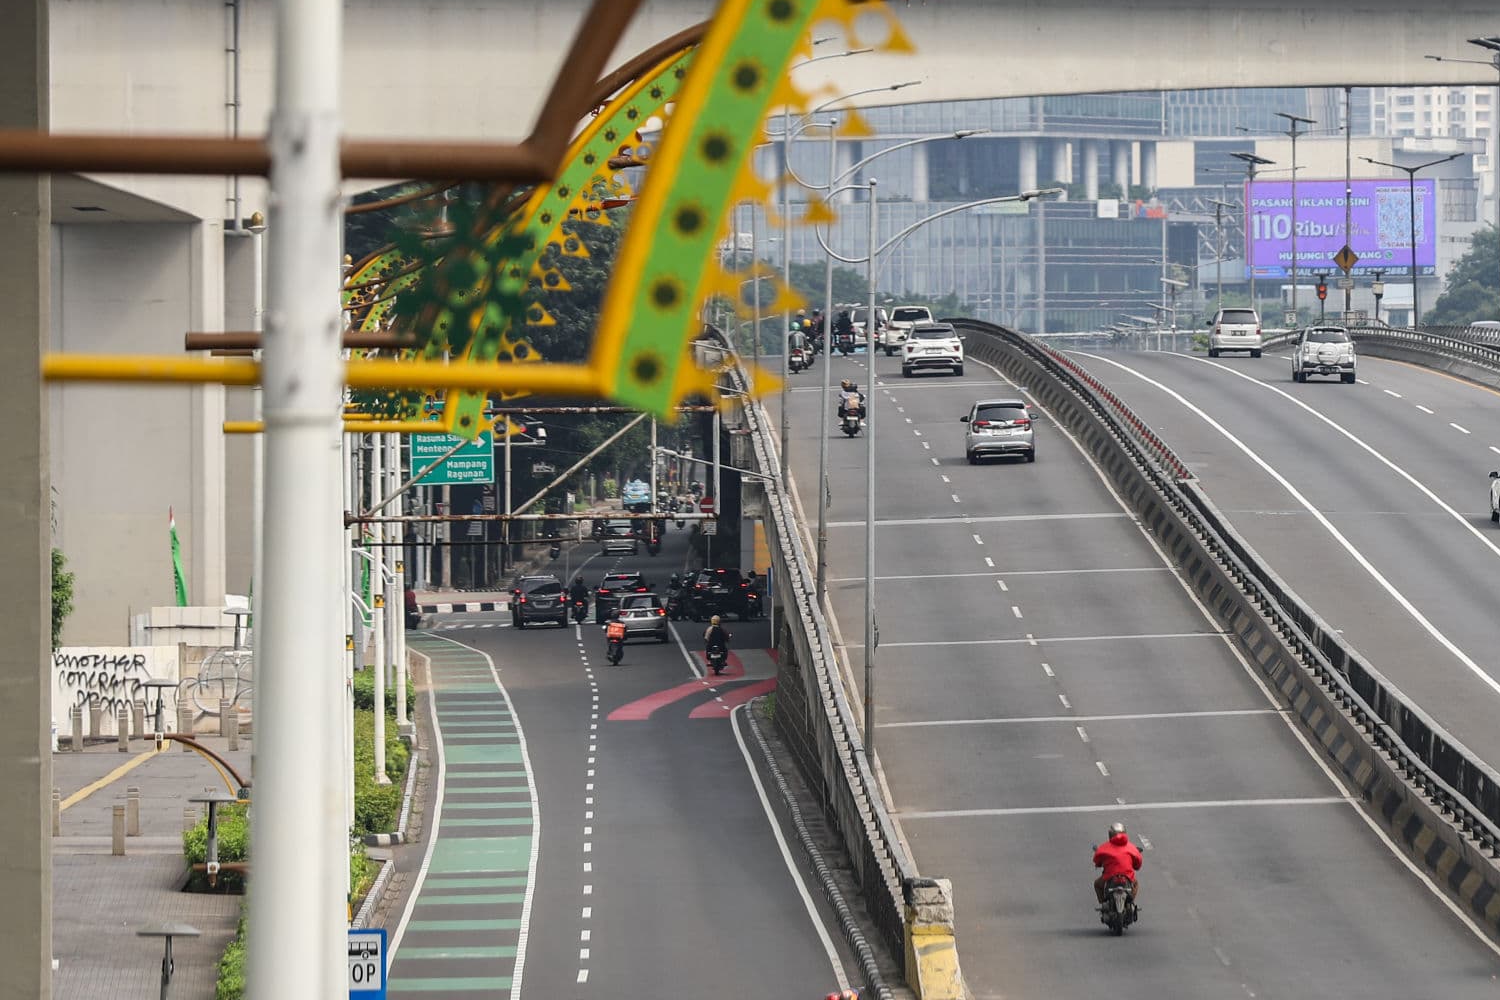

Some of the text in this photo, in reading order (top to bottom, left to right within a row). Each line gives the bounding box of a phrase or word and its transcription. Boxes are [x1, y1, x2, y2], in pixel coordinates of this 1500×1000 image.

[1300, 198, 1333, 207] IKLAN
[1252, 213, 1292, 241] 110
[446, 460, 487, 470] Mampang
[446, 470, 484, 480] Ragunan
[352, 963, 376, 983] OP
